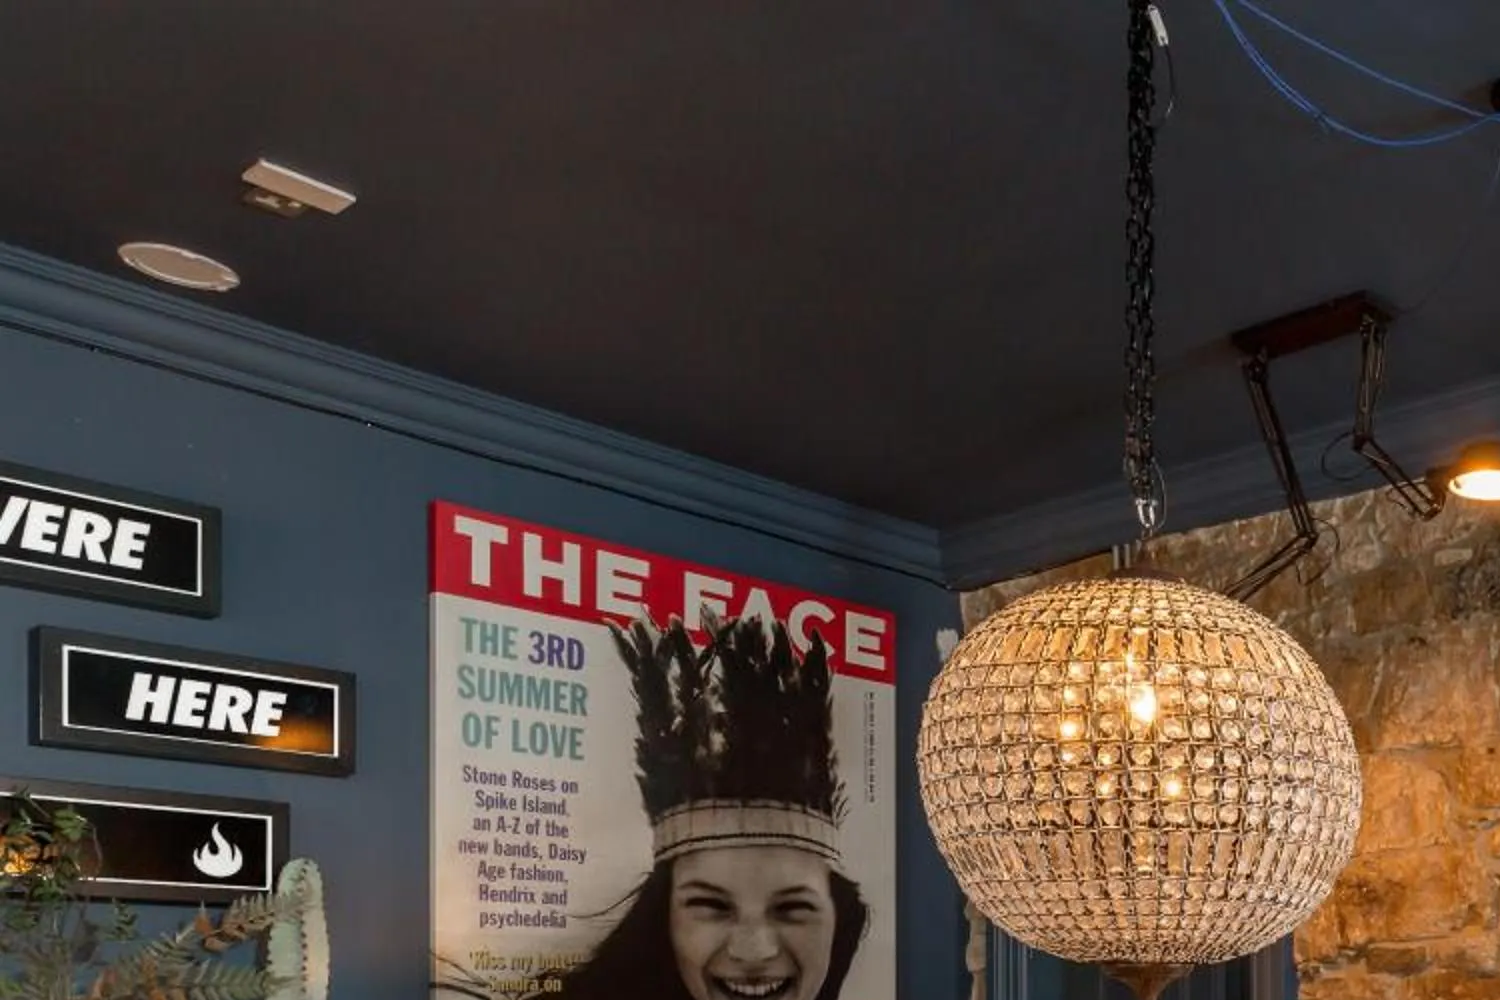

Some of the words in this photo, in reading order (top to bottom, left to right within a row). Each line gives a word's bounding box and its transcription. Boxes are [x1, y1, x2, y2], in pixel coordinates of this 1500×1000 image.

[453, 514, 651, 617] THE
[683, 570, 887, 671] FACE
[459, 616, 519, 660] THE
[528, 630, 585, 671] 3RD
[457, 664, 588, 717] SUMMER
[125, 673, 287, 737] HERE
[462, 711, 501, 750] OF
[511, 719, 585, 761] LOVE
[463, 765, 507, 787] Stone
[511, 771, 557, 792] Roses
[561, 781, 579, 794] on
[475, 789, 517, 811] Spike
[473, 817, 491, 832] an
[496, 816, 521, 835] A-Z
[525, 819, 540, 836] of
[545, 821, 569, 838] the
[458, 839, 489, 855] new
[494, 838, 543, 861] bands,
[548, 843, 587, 865] Daisy
[477, 860, 506, 882] Age
[479, 884, 536, 904] Hendrix
[541, 890, 568, 906] and
[479, 909, 567, 929] psychedelia
[544, 979, 562, 993] on
